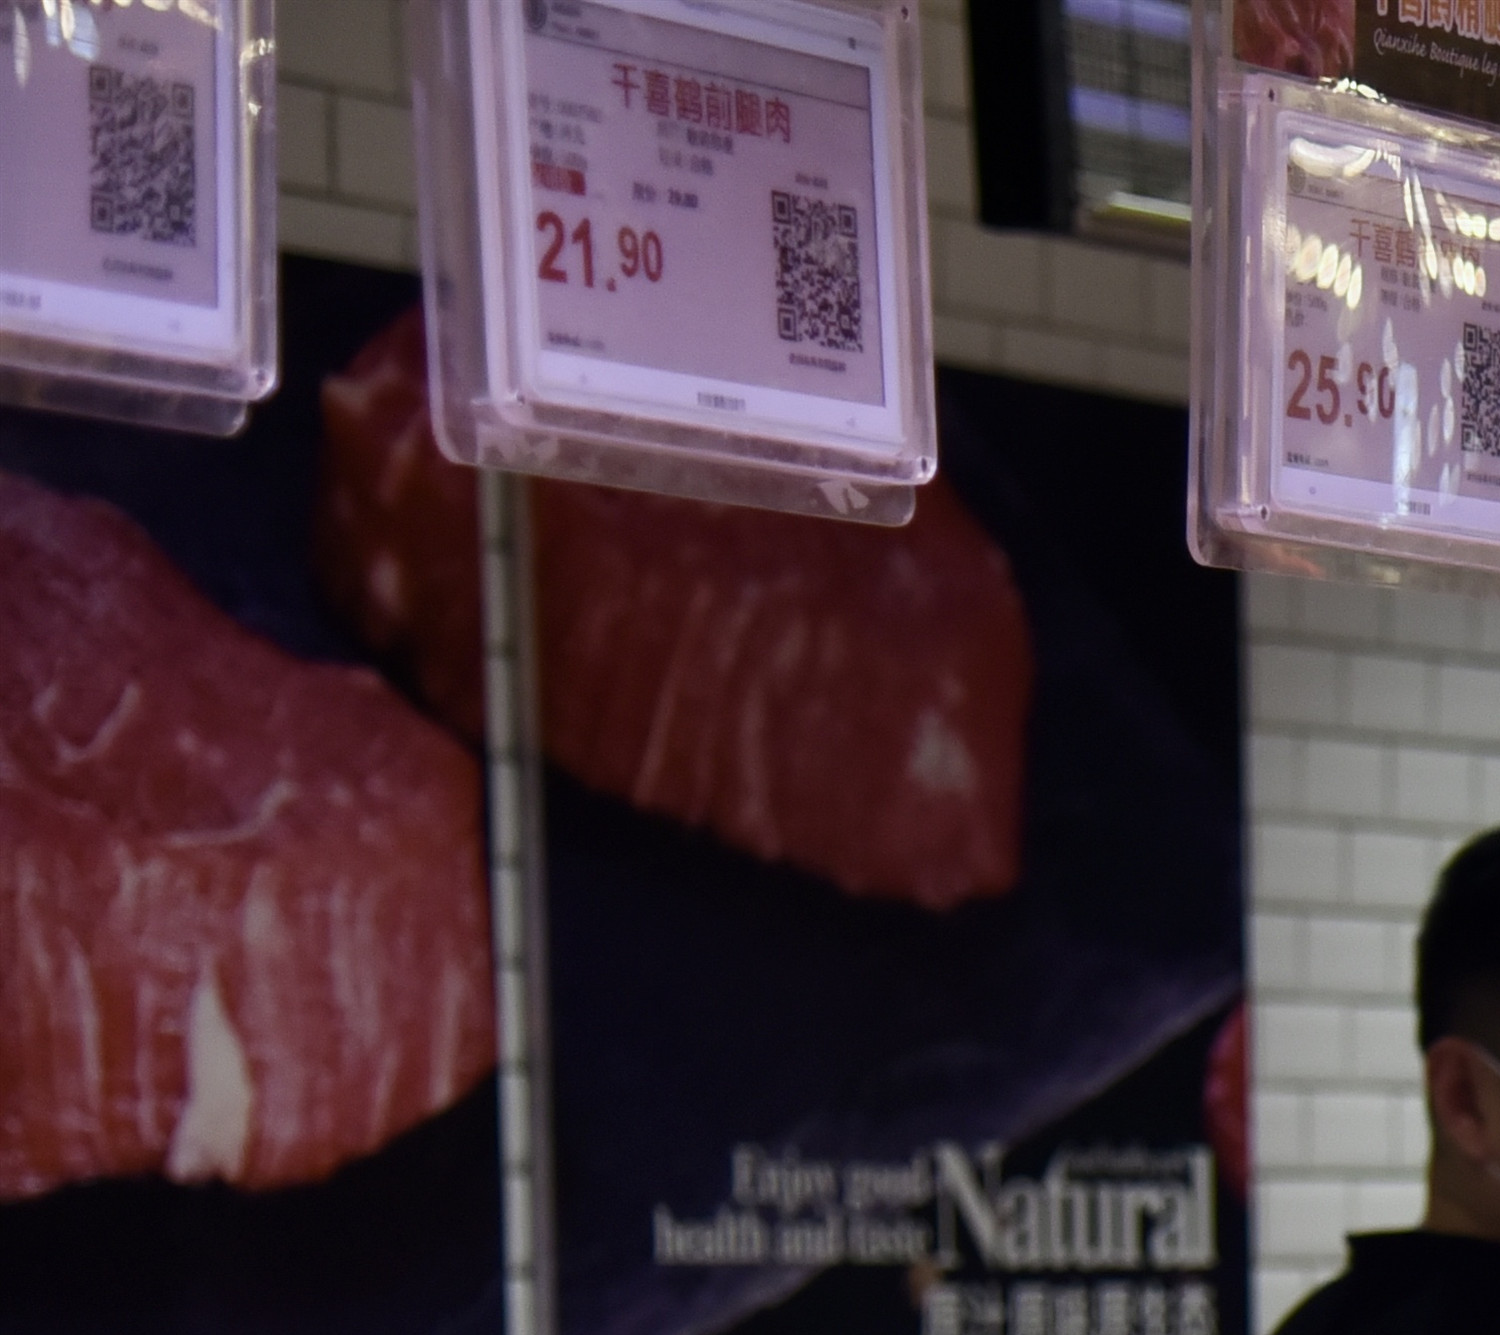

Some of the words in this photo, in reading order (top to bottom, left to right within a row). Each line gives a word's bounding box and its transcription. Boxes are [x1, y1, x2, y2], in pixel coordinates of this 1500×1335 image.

[1373, 27, 1428, 57] Qianxihe
[1429, 41, 1480, 78] Boutique
[1481, 53, 1498, 87] leg
[611, 62, 792, 144] 千喜鹤前腿肉
[536, 210, 664, 293] 21.90
[1286, 349, 1396, 428] 25.90
[731, 1142, 837, 1218] Enjoy
[934, 1141, 1218, 1271] Natural
[652, 1202, 768, 1266] health
[775, 1206, 845, 1266] and
